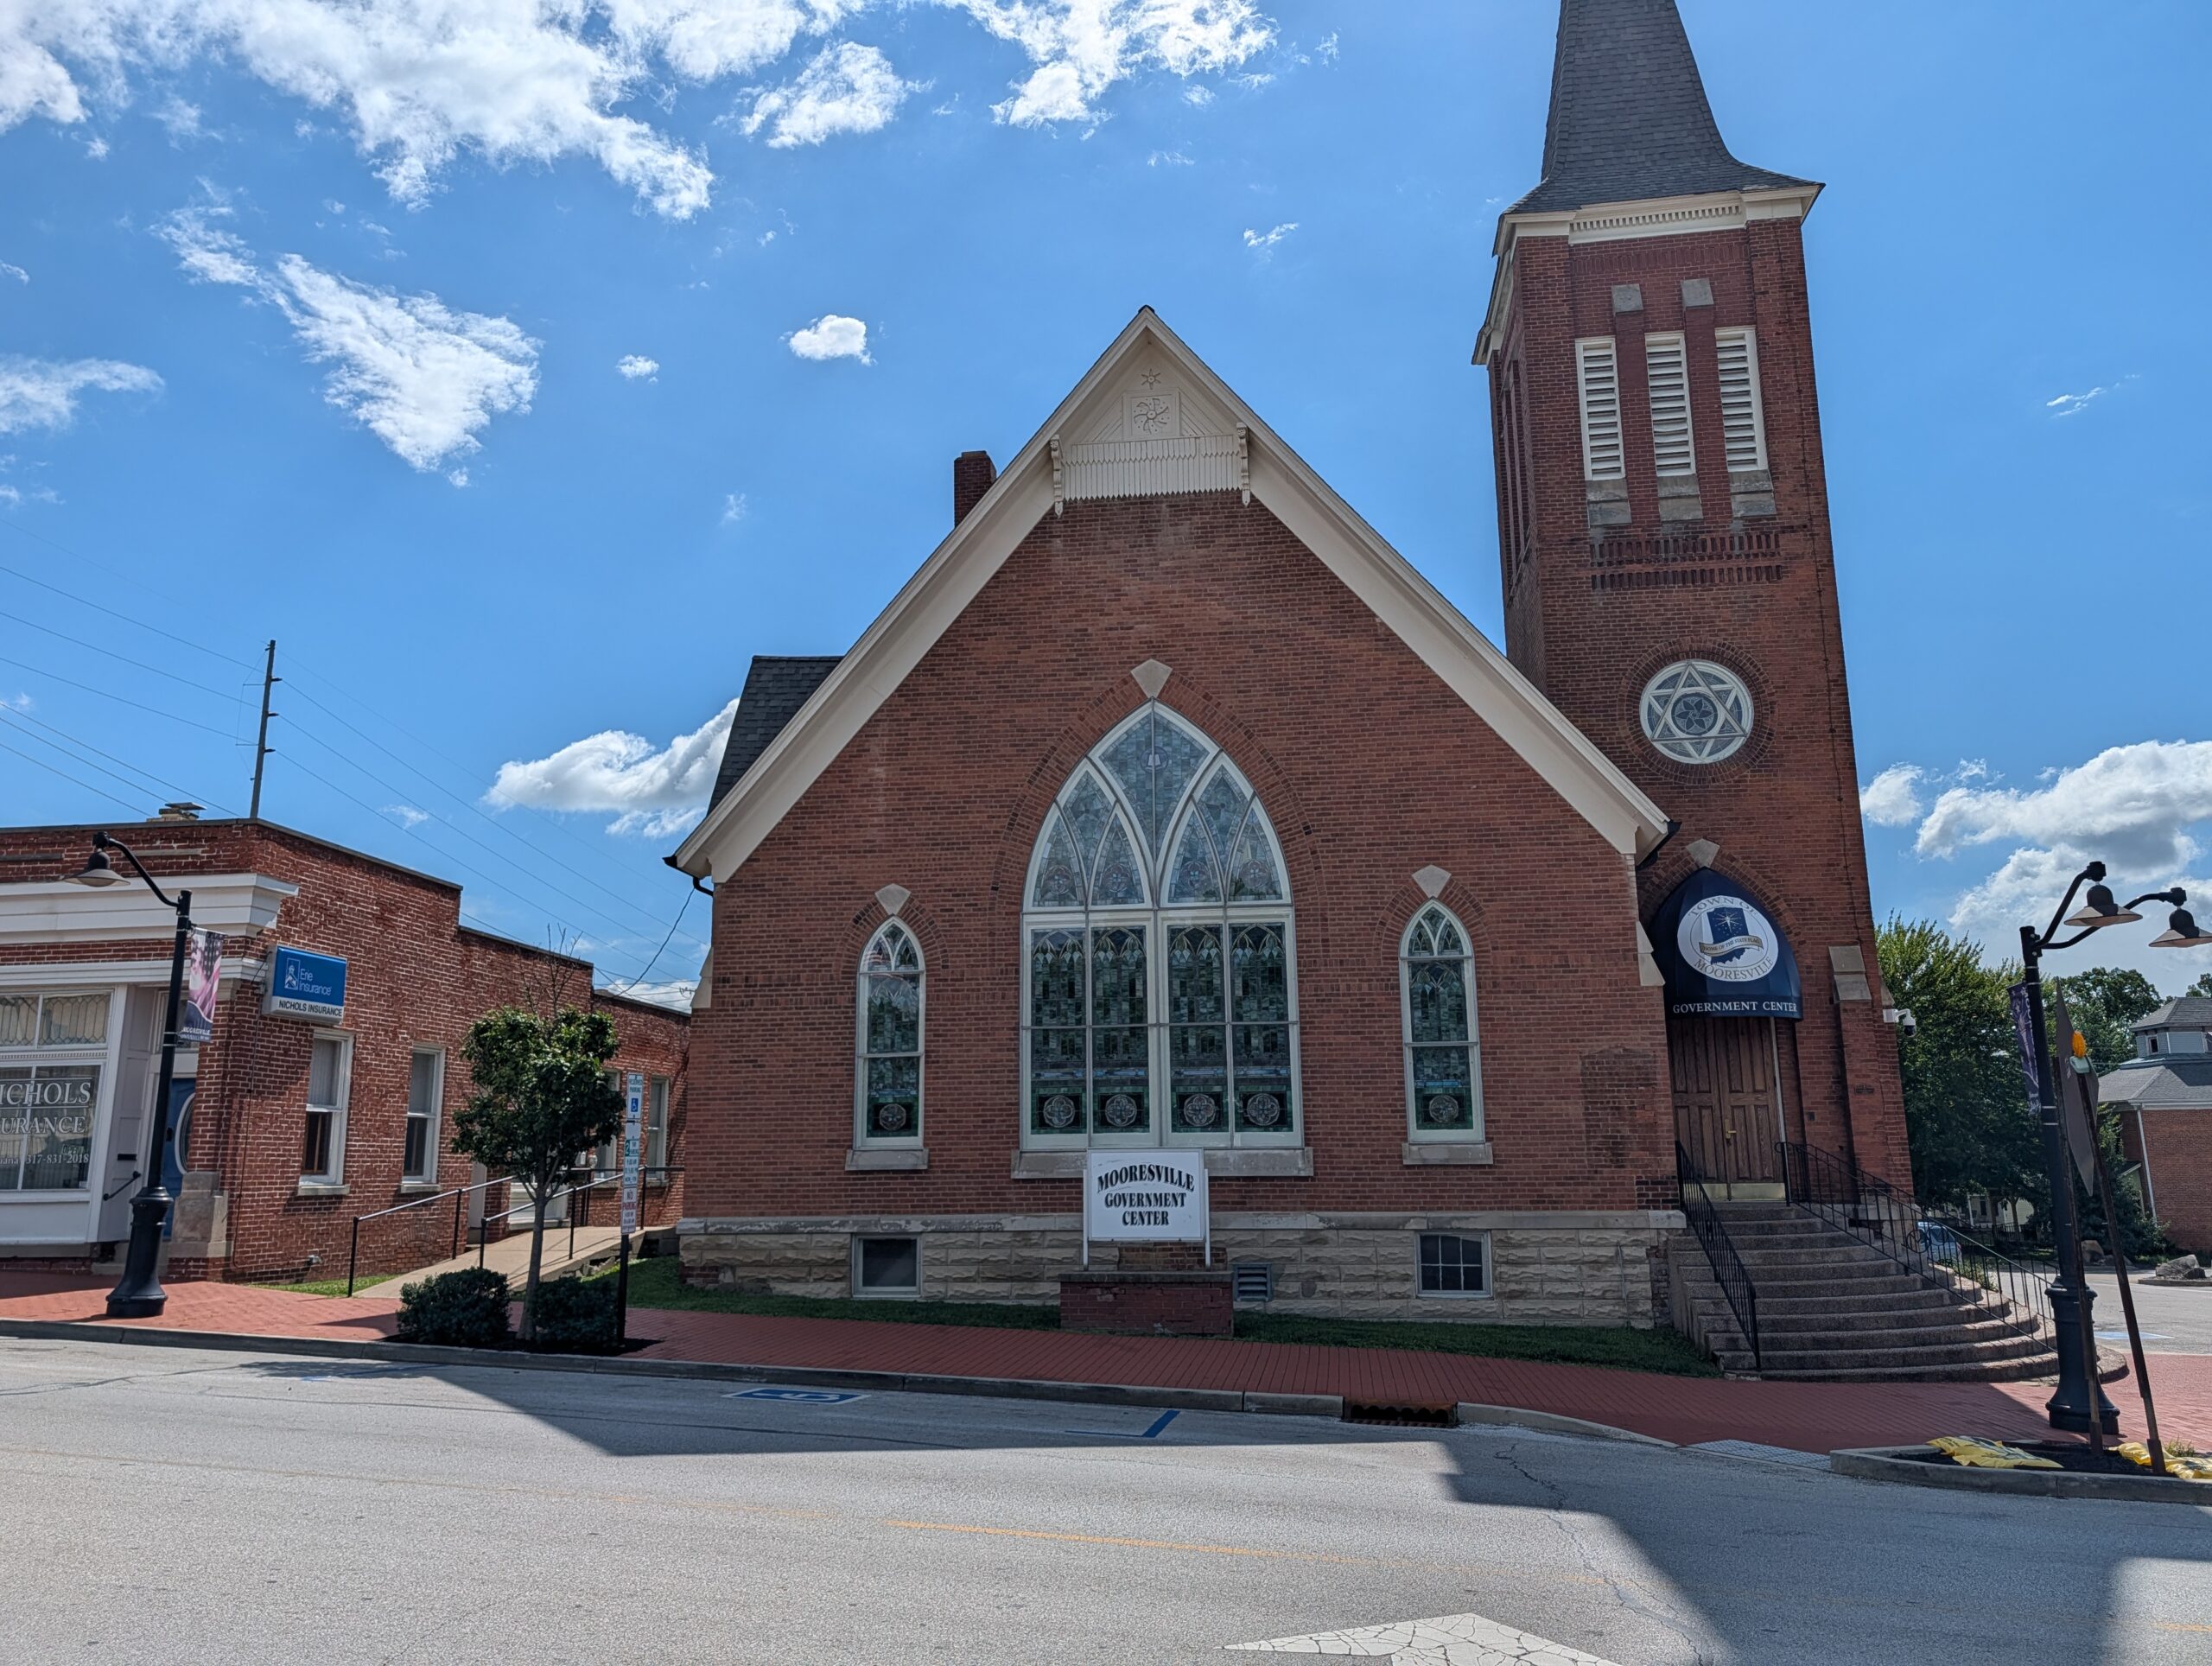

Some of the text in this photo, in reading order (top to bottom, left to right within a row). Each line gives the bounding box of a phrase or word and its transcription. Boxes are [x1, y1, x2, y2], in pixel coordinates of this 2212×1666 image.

[1688, 897, 1734, 916] TOWN
[300, 968, 314, 982] Erie
[1694, 956, 1774, 980] MOORESVILLE
[279, 1000, 342, 1017] NICHOLS INSURANCE
[1673, 1001, 1797, 1014] GOVERNMENT CENTER
[1, 1116, 86, 1135] URANCE
[26, 1153, 90, 1165] 317-831-2018
[1097, 1164, 1195, 1192] MOORESVILLE
[1104, 1192, 1187, 1208] GOVERNMENT
[1122, 1211, 1170, 1226] CENTER
